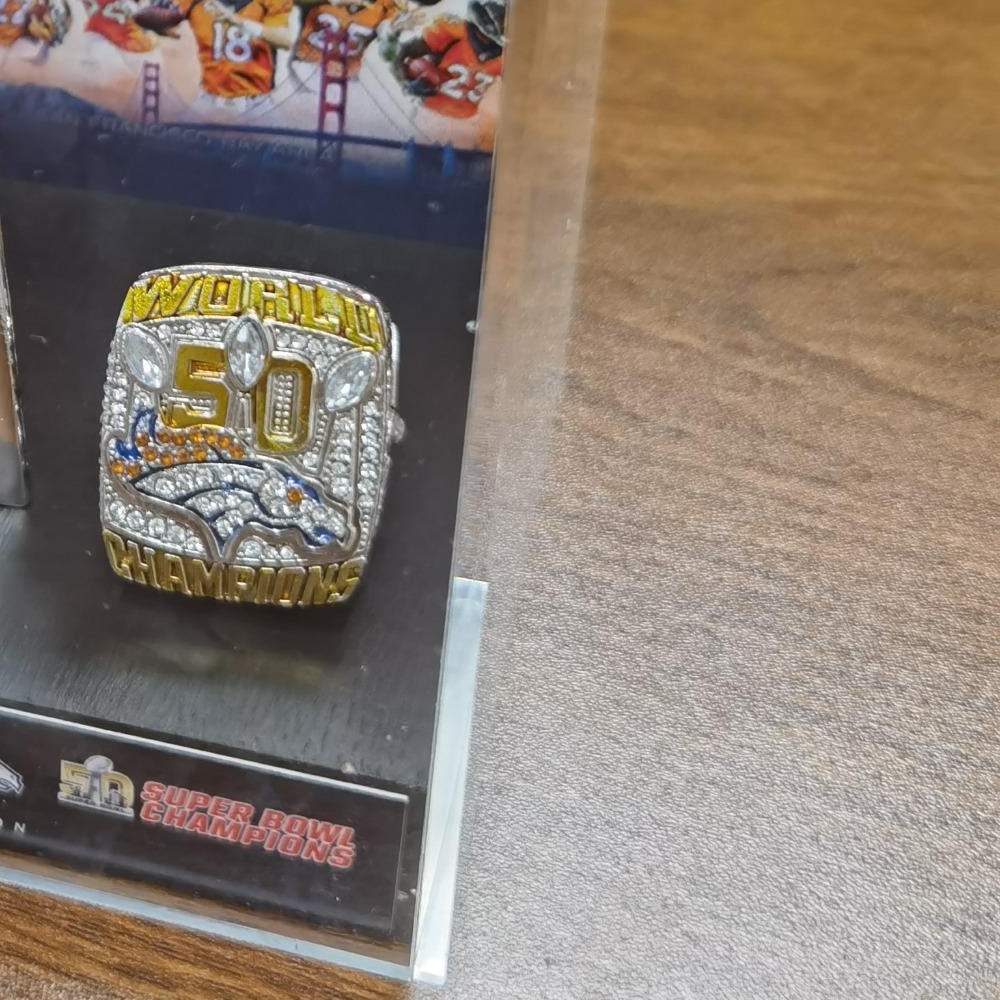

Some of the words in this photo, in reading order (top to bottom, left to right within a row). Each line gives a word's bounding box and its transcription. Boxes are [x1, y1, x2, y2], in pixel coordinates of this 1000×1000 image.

[213, 22, 252, 63] 18
[120, 271, 384, 352] WORLD
[160, 342, 315, 454] 50
[102, 529, 363, 607] CHAMPIONS
[140, 801, 356, 871] CHAMPIONS
[141, 780, 255, 825] SUPER
[258, 807, 355, 849] BOWL
